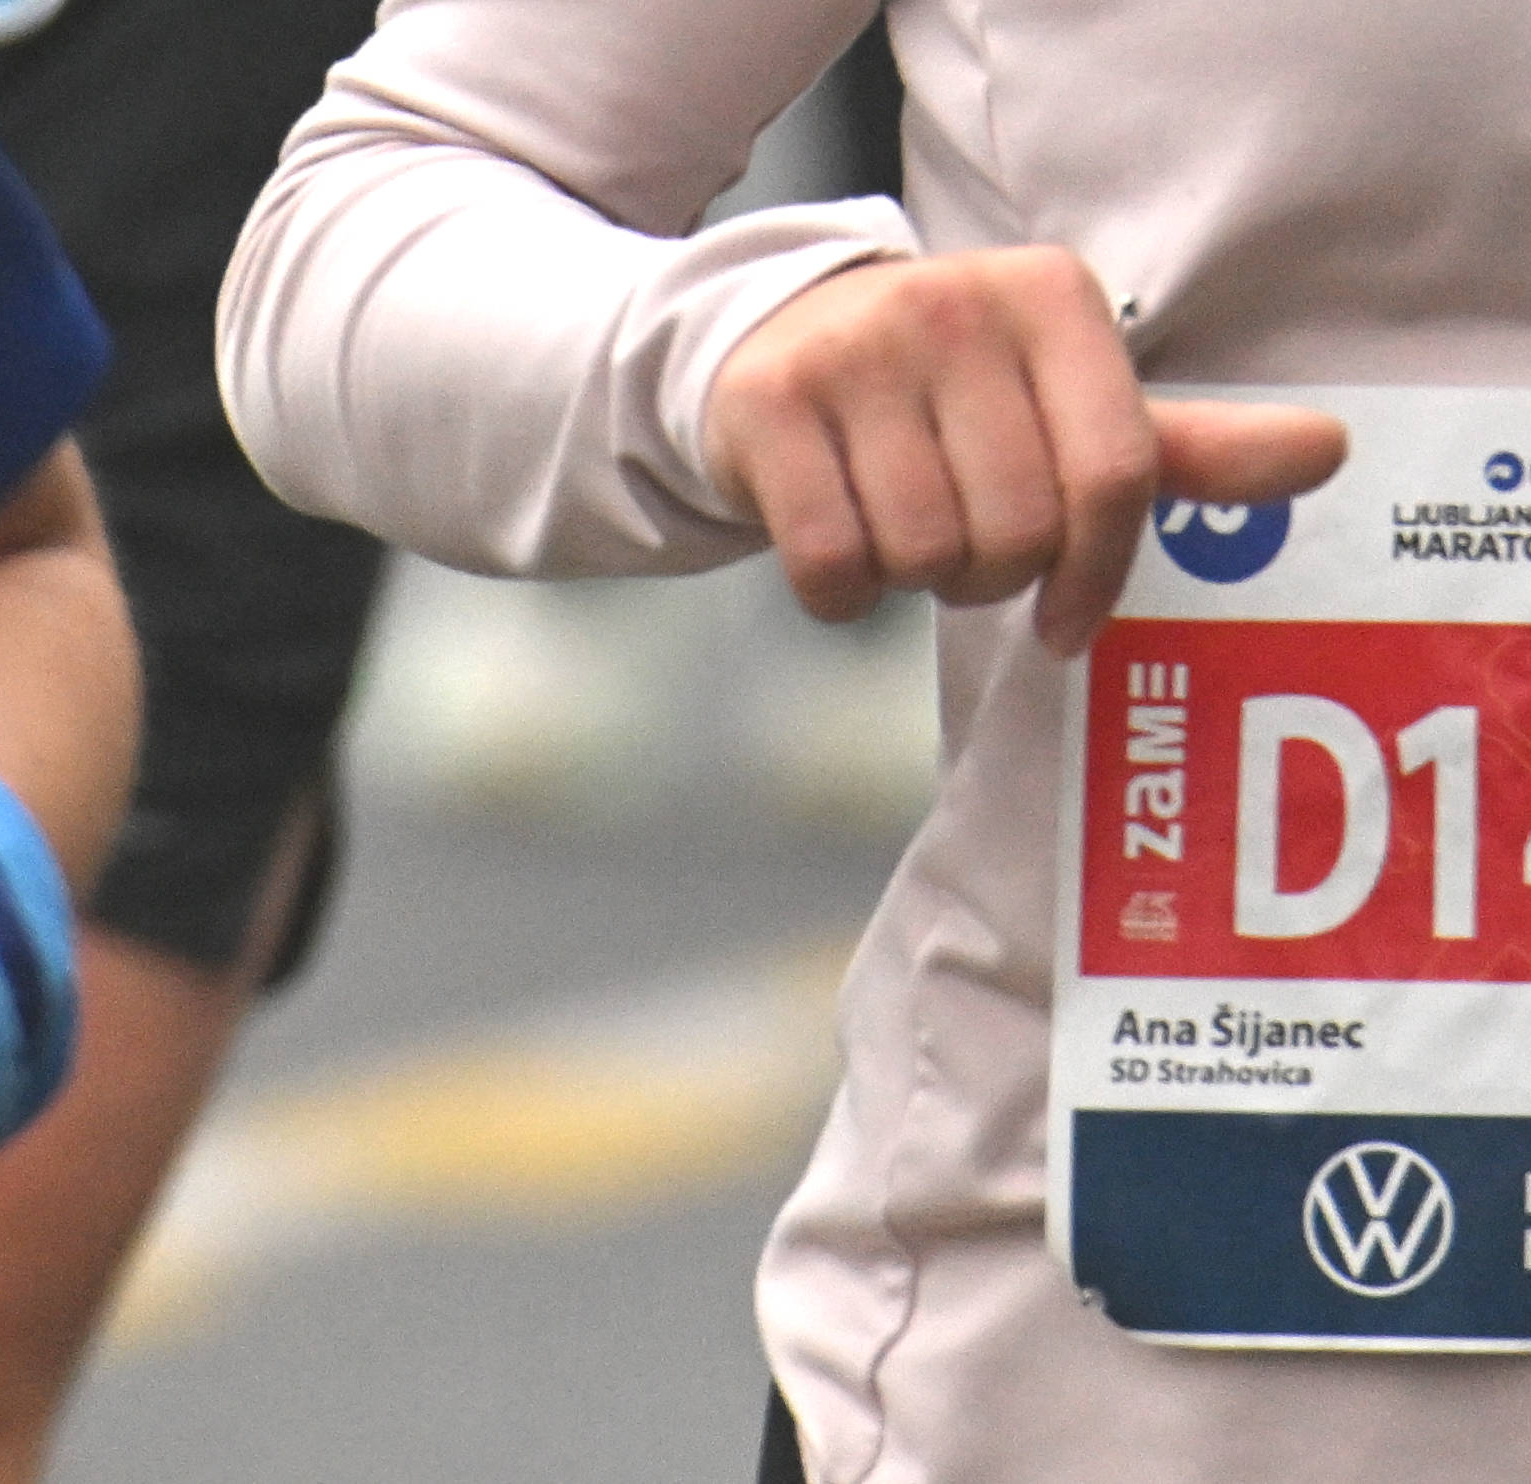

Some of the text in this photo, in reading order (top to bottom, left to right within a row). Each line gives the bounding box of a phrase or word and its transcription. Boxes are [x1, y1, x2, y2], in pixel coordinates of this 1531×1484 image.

[1112, 1002, 1365, 1057] Ana Šijanec
[1110, 1057, 1313, 1087] SD Strahovica
